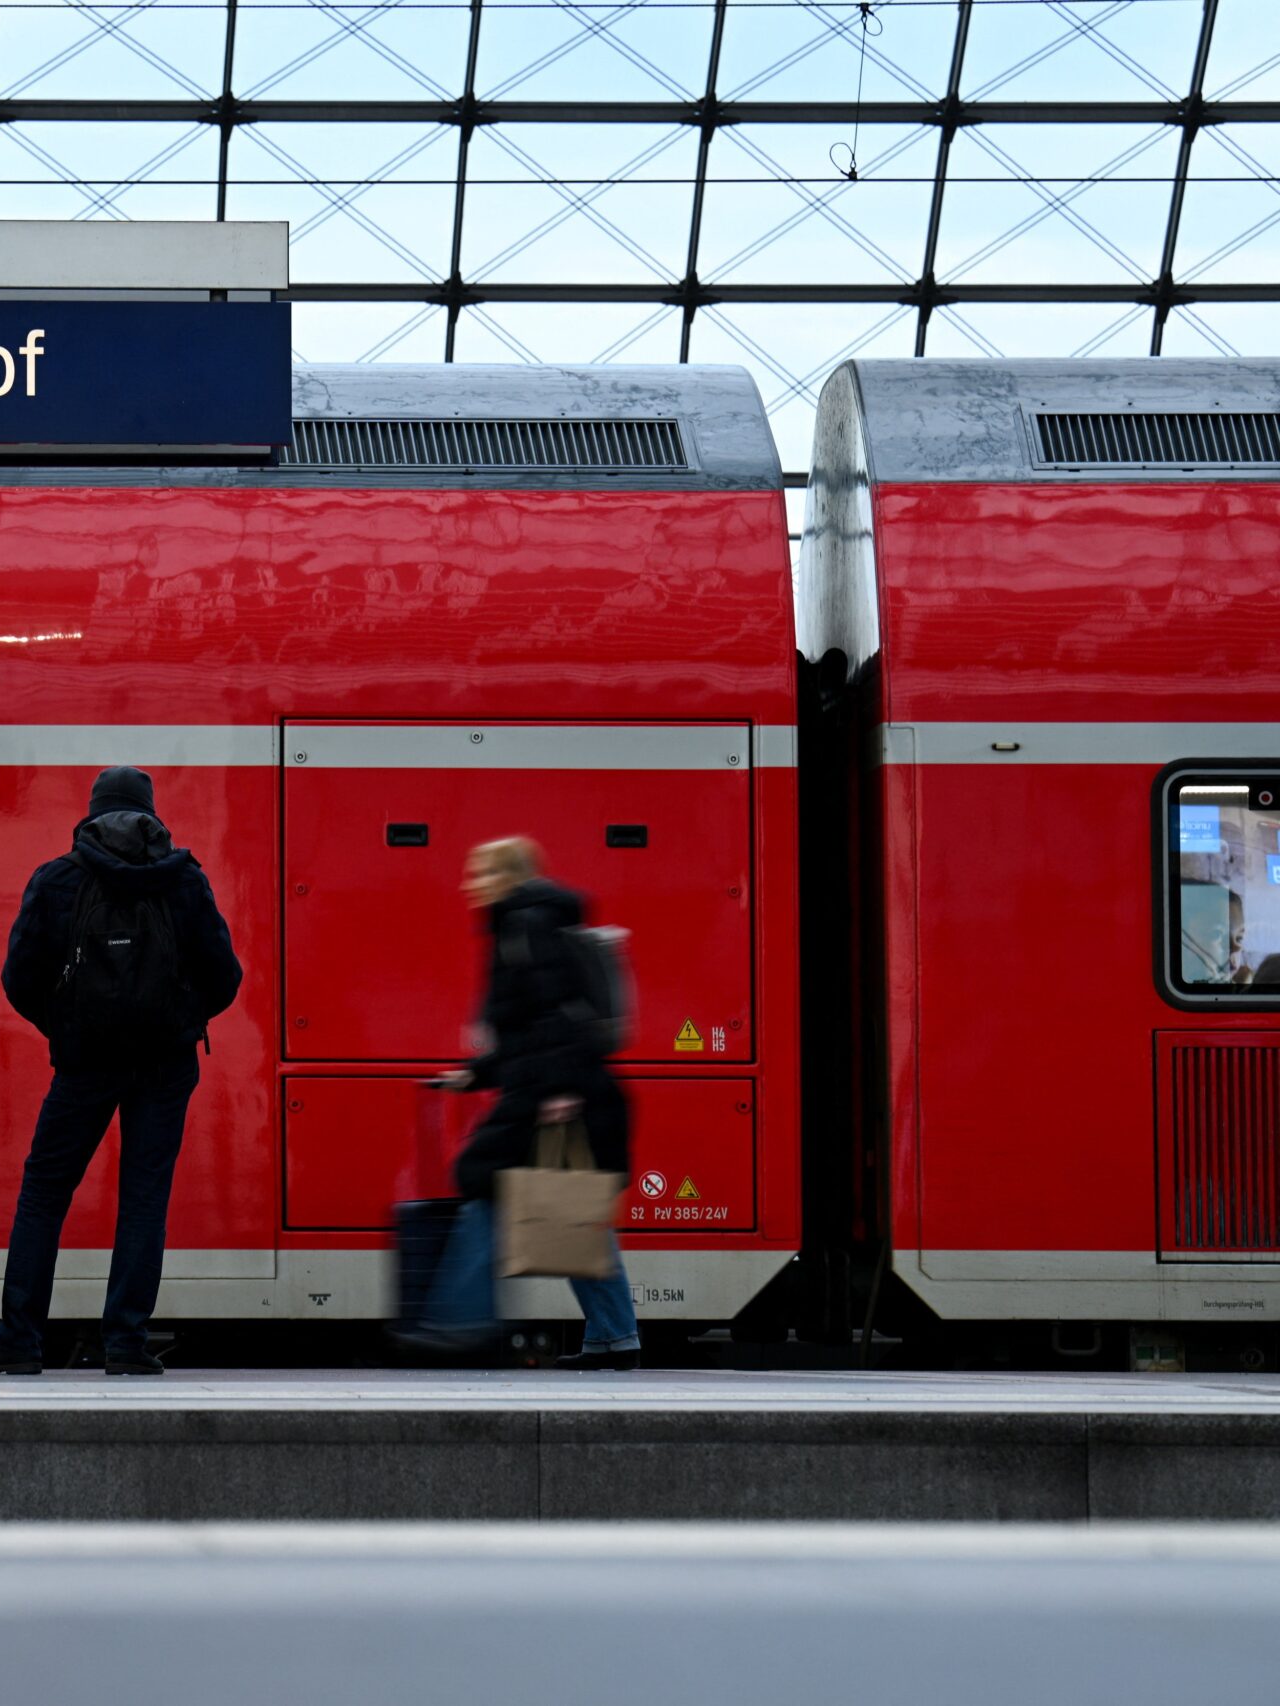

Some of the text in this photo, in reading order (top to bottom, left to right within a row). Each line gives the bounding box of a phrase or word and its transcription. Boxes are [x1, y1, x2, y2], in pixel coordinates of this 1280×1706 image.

[712, 1027, 725, 1039] H4
[712, 1039, 725, 1052] H5
[631, 1207, 728, 1220] S2 PzV 385/24V
